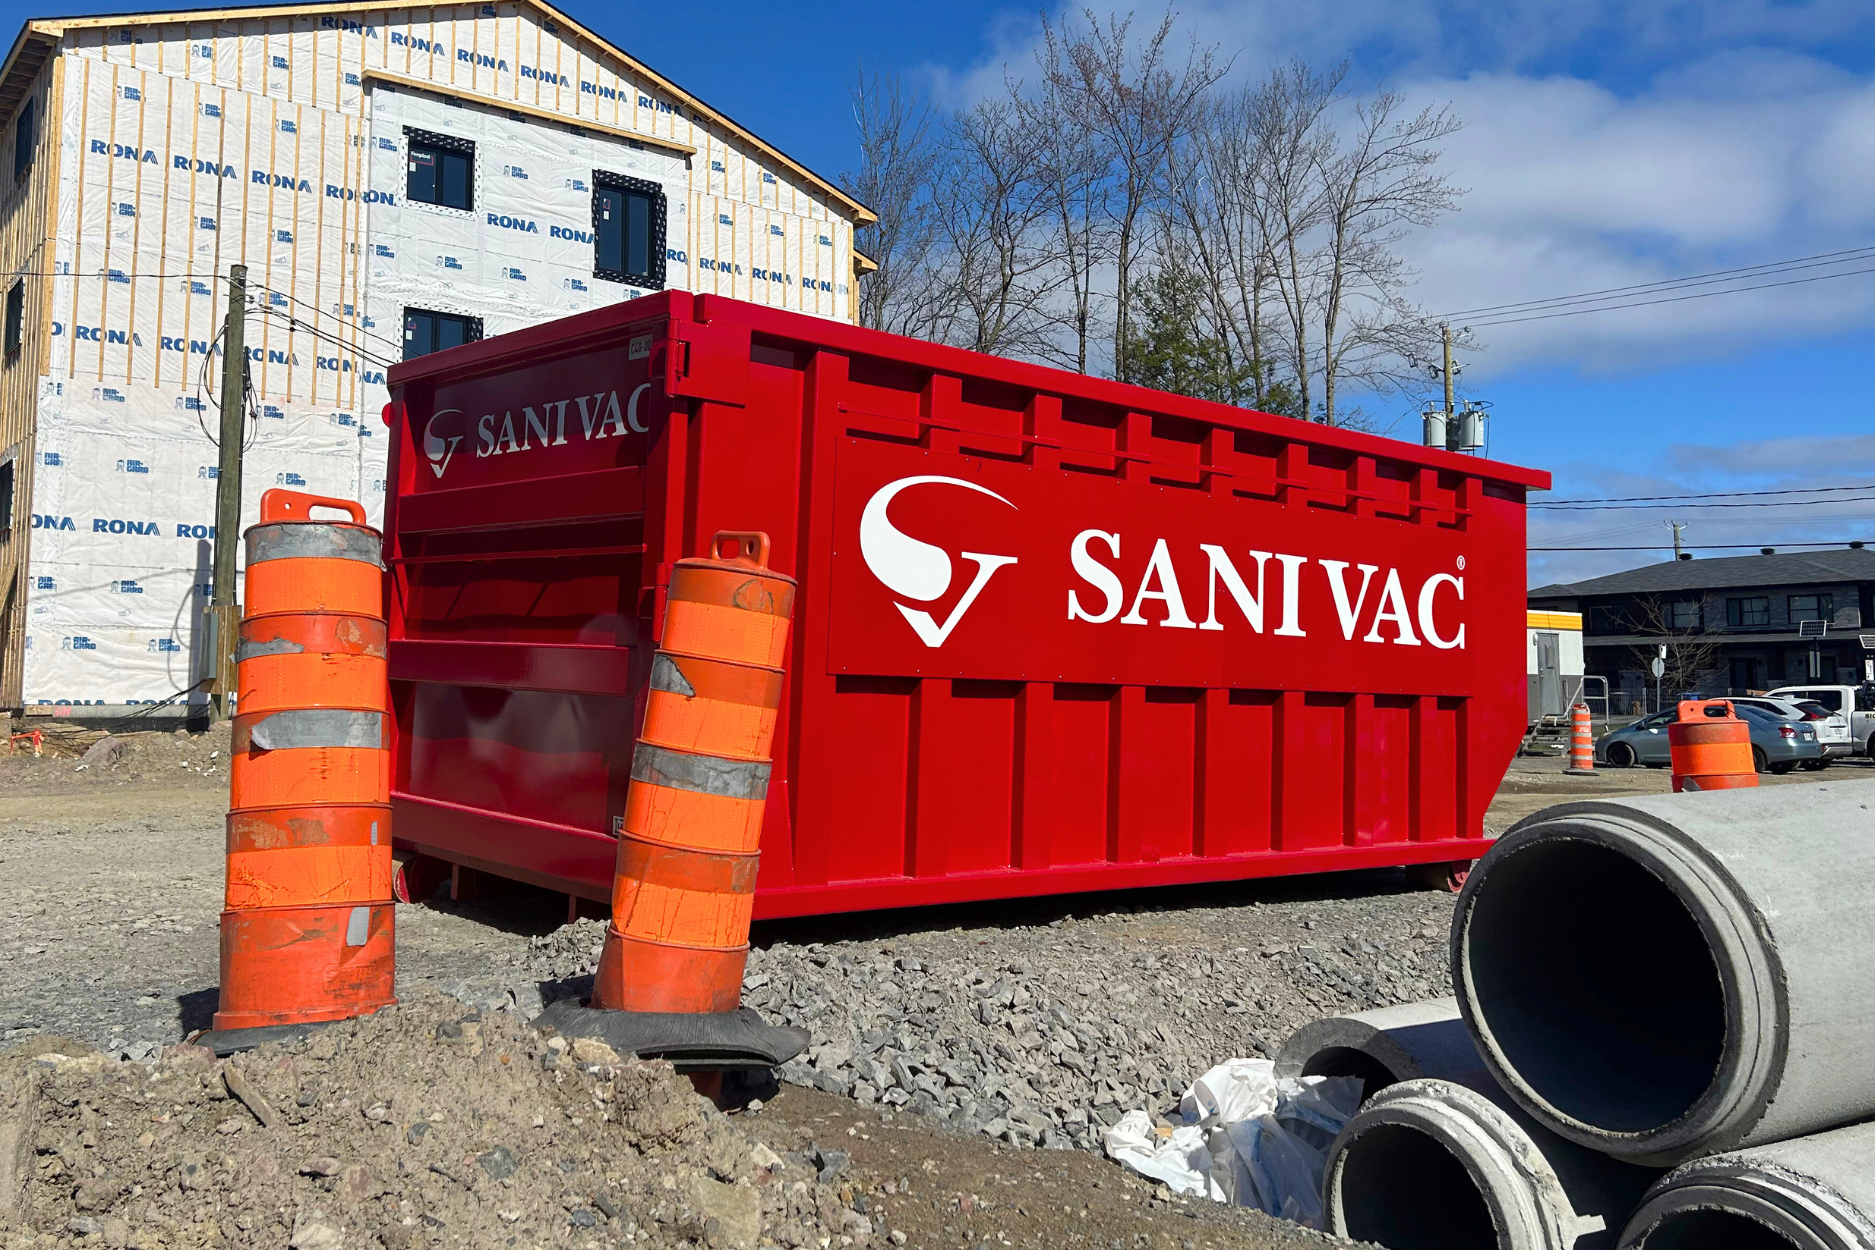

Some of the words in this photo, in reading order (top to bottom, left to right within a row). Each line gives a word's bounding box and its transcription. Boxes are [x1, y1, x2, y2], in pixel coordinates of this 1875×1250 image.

[321, 16, 378, 40] RONA
[391, 31, 445, 56] RONA
[458, 48, 509, 73] RONA
[520, 65, 570, 88] RONA
[581, 81, 628, 103] RONA
[638, 95, 683, 118] RONA
[379, 142, 397, 151] GARD
[91, 139, 158, 165] RONA
[174, 155, 237, 179] RONA
[512, 171, 528, 180] GARD
[252, 170, 312, 193] RONA
[487, 213, 539, 234] RONA
[376, 250, 395, 258] GARD
[445, 261, 462, 270] GARD
[700, 257, 743, 276] RONA
[108, 275, 130, 284] GARD
[509, 273, 527, 281] GARD
[752, 267, 793, 286] RONA
[191, 287, 211, 296] GARD
[571, 284, 587, 292] GARD
[75, 325, 143, 347] RONA
[263, 411, 284, 419] GARD
[127, 459, 143, 468] AIR-
[126, 466, 149, 474] GARD
[285, 478, 306, 486] GARD
[93, 518, 161, 536] RONA
[121, 580, 138, 588] AIR-
[120, 586, 143, 594] GARD
[73, 637, 91, 645] AIR-
[158, 638, 176, 646] AIR-
[158, 644, 181, 652] GARD
